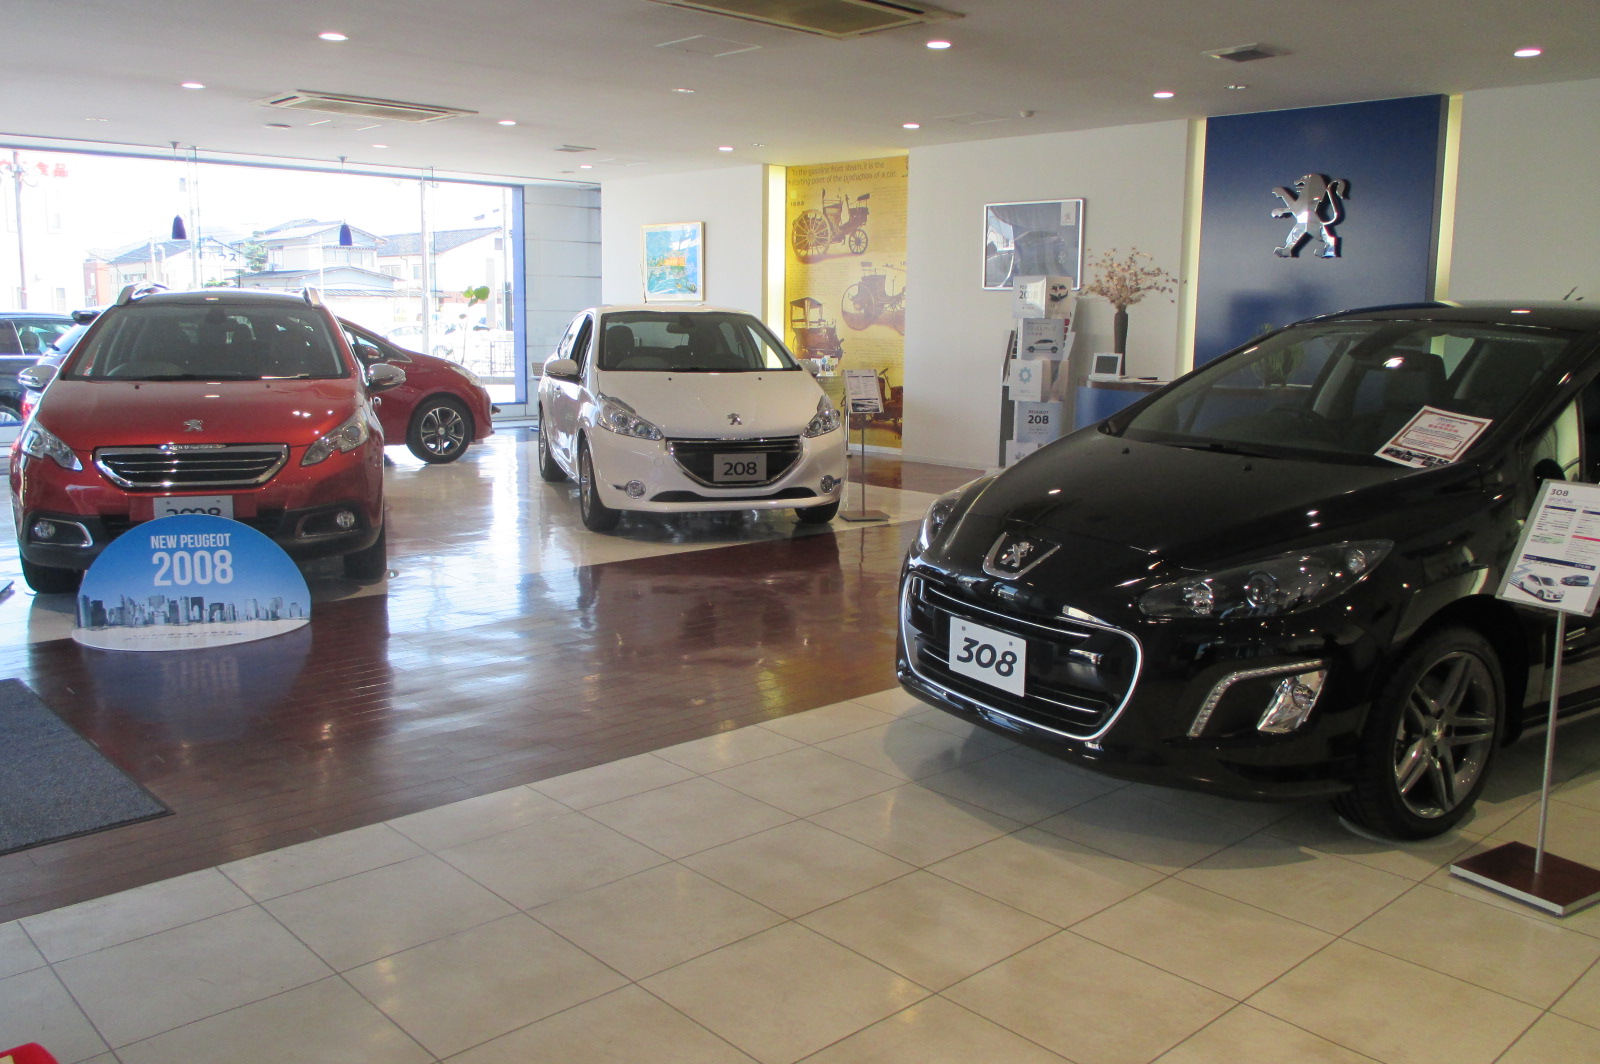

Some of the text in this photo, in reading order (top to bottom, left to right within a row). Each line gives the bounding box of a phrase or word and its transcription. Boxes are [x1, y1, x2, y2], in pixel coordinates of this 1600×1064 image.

[799, 168, 808, 176] the
[808, 166, 830, 177] gasoline
[831, 164, 844, 172] from
[874, 160, 885, 169] the
[792, 177, 811, 186] starting
[811, 176, 826, 185] point
[826, 174, 832, 183] of
[832, 174, 843, 182] the
[844, 172, 873, 184] production
[873, 170, 880, 179] of
[1028, 414, 1049, 424] 208
[723, 462, 758, 476] 208
[1550, 488, 1569, 496] 308
[151, 533, 231, 549] NEW PEUGEOT
[152, 550, 234, 586] 2008
[956, 636, 1018, 677] 308
